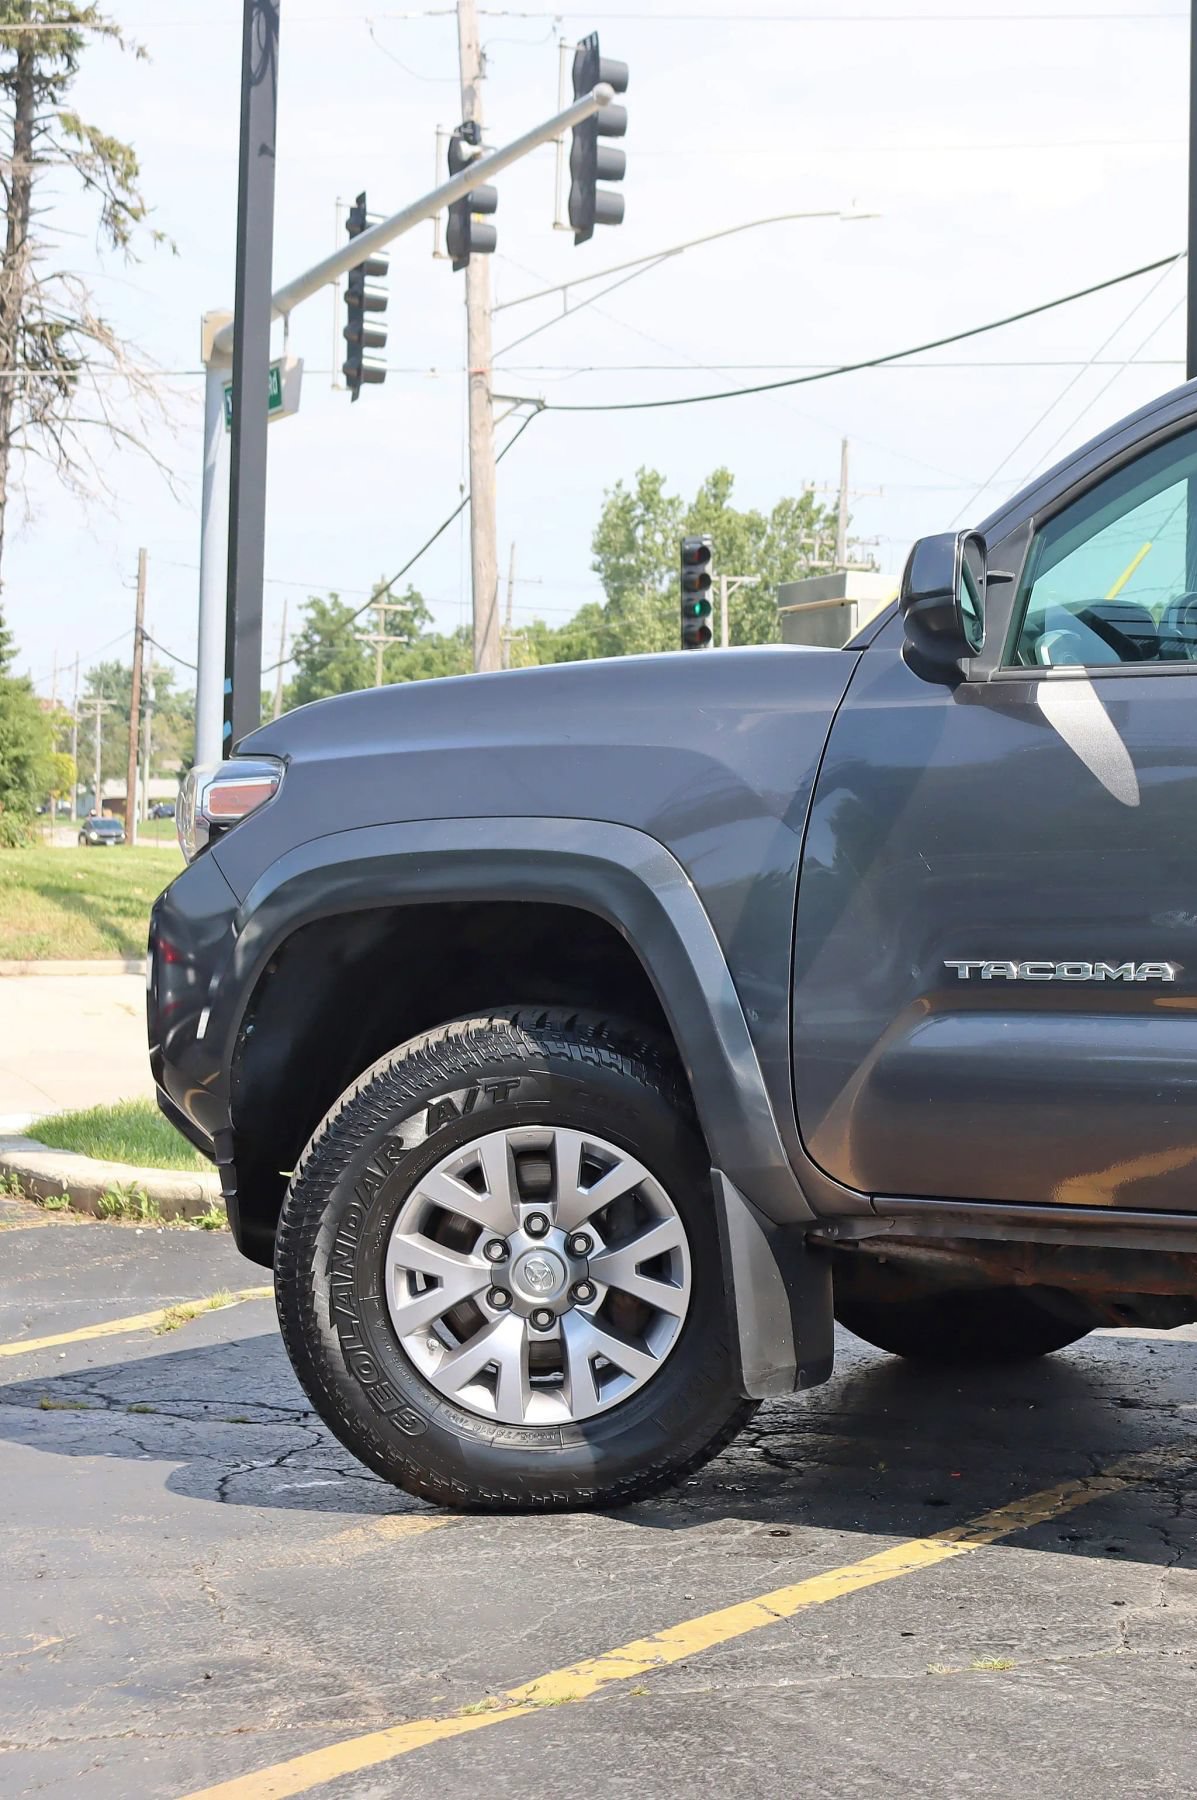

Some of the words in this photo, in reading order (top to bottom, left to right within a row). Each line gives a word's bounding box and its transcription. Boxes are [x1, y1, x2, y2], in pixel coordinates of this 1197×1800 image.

[943, 960, 1175, 982] TACOMA
[329, 1135, 429, 1436] GEOLANDAR
[426, 1077, 521, 1137] A/T
